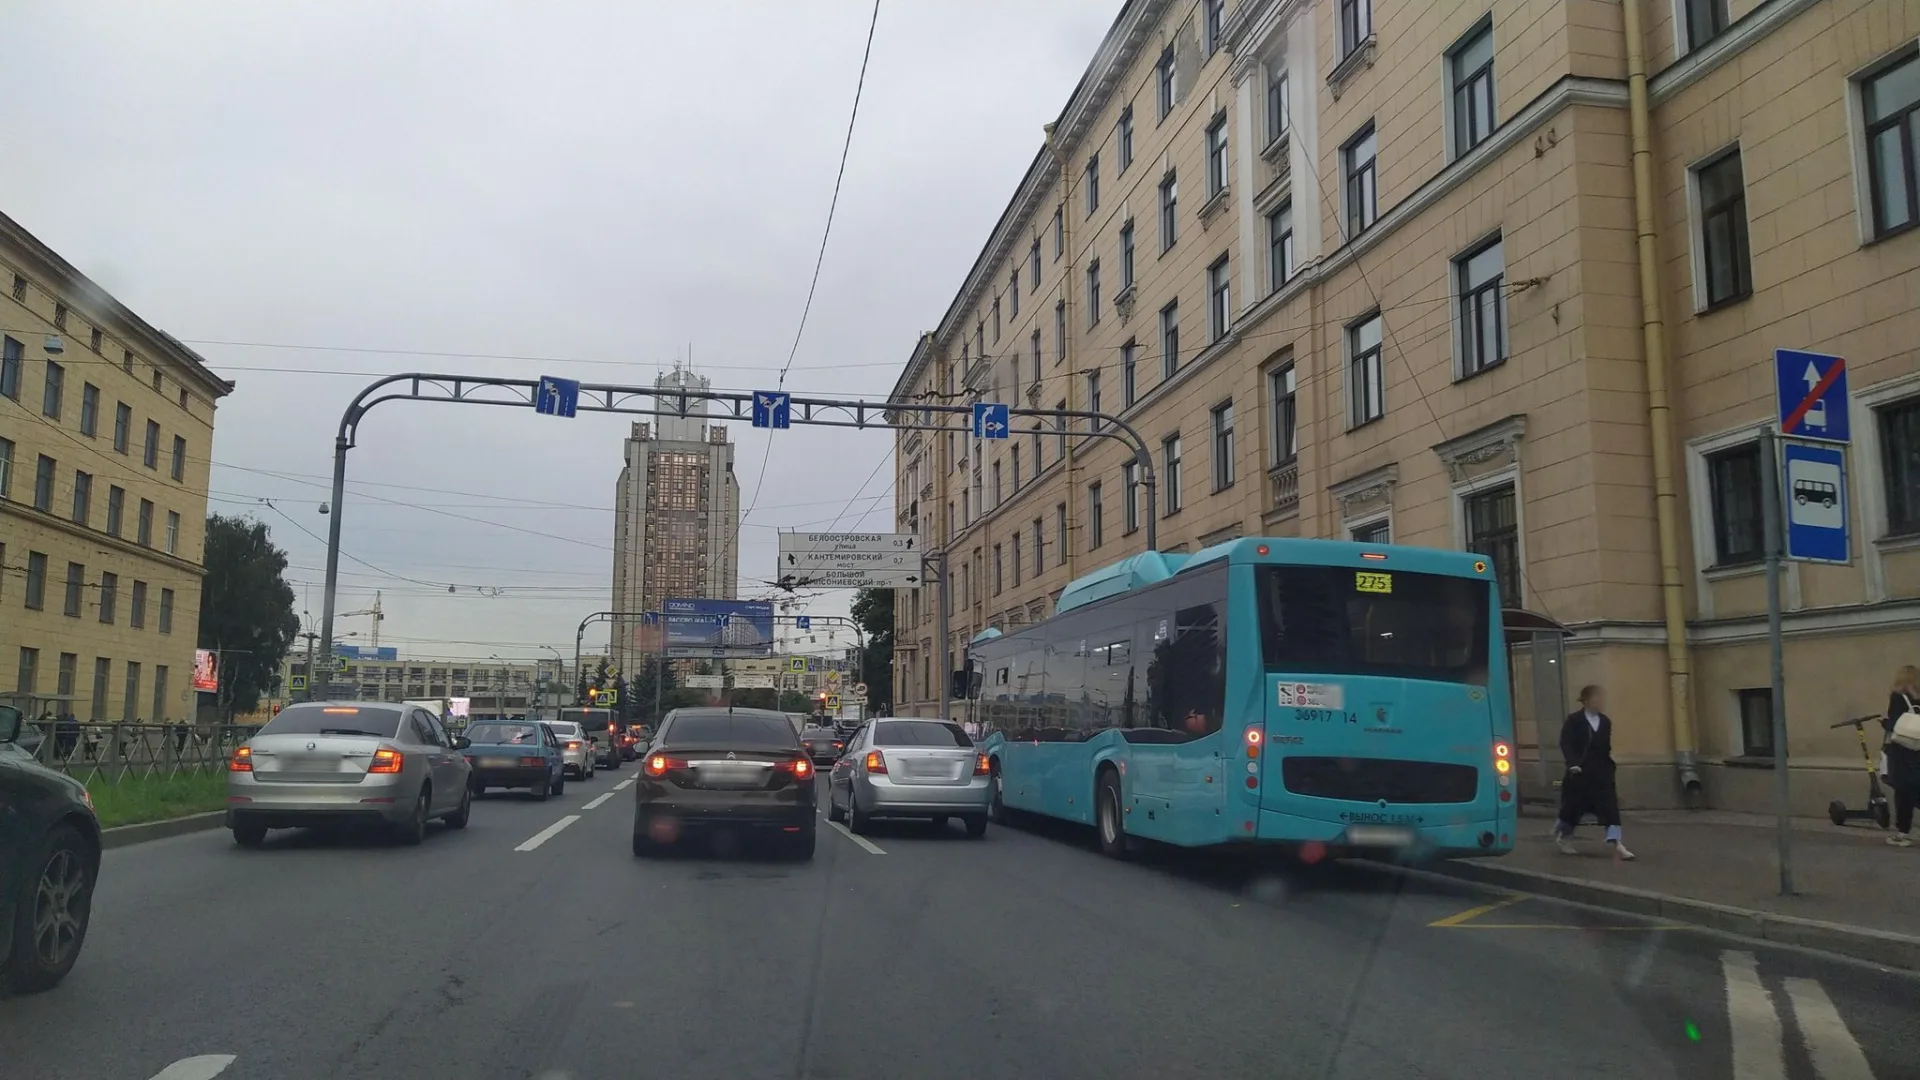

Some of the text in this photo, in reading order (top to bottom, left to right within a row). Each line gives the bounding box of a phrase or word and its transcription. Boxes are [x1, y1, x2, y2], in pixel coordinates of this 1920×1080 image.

[893, 557, 903, 565] 0,7
[1359, 575, 1386, 590] 275
[1295, 709, 1357, 724] 36917 14
